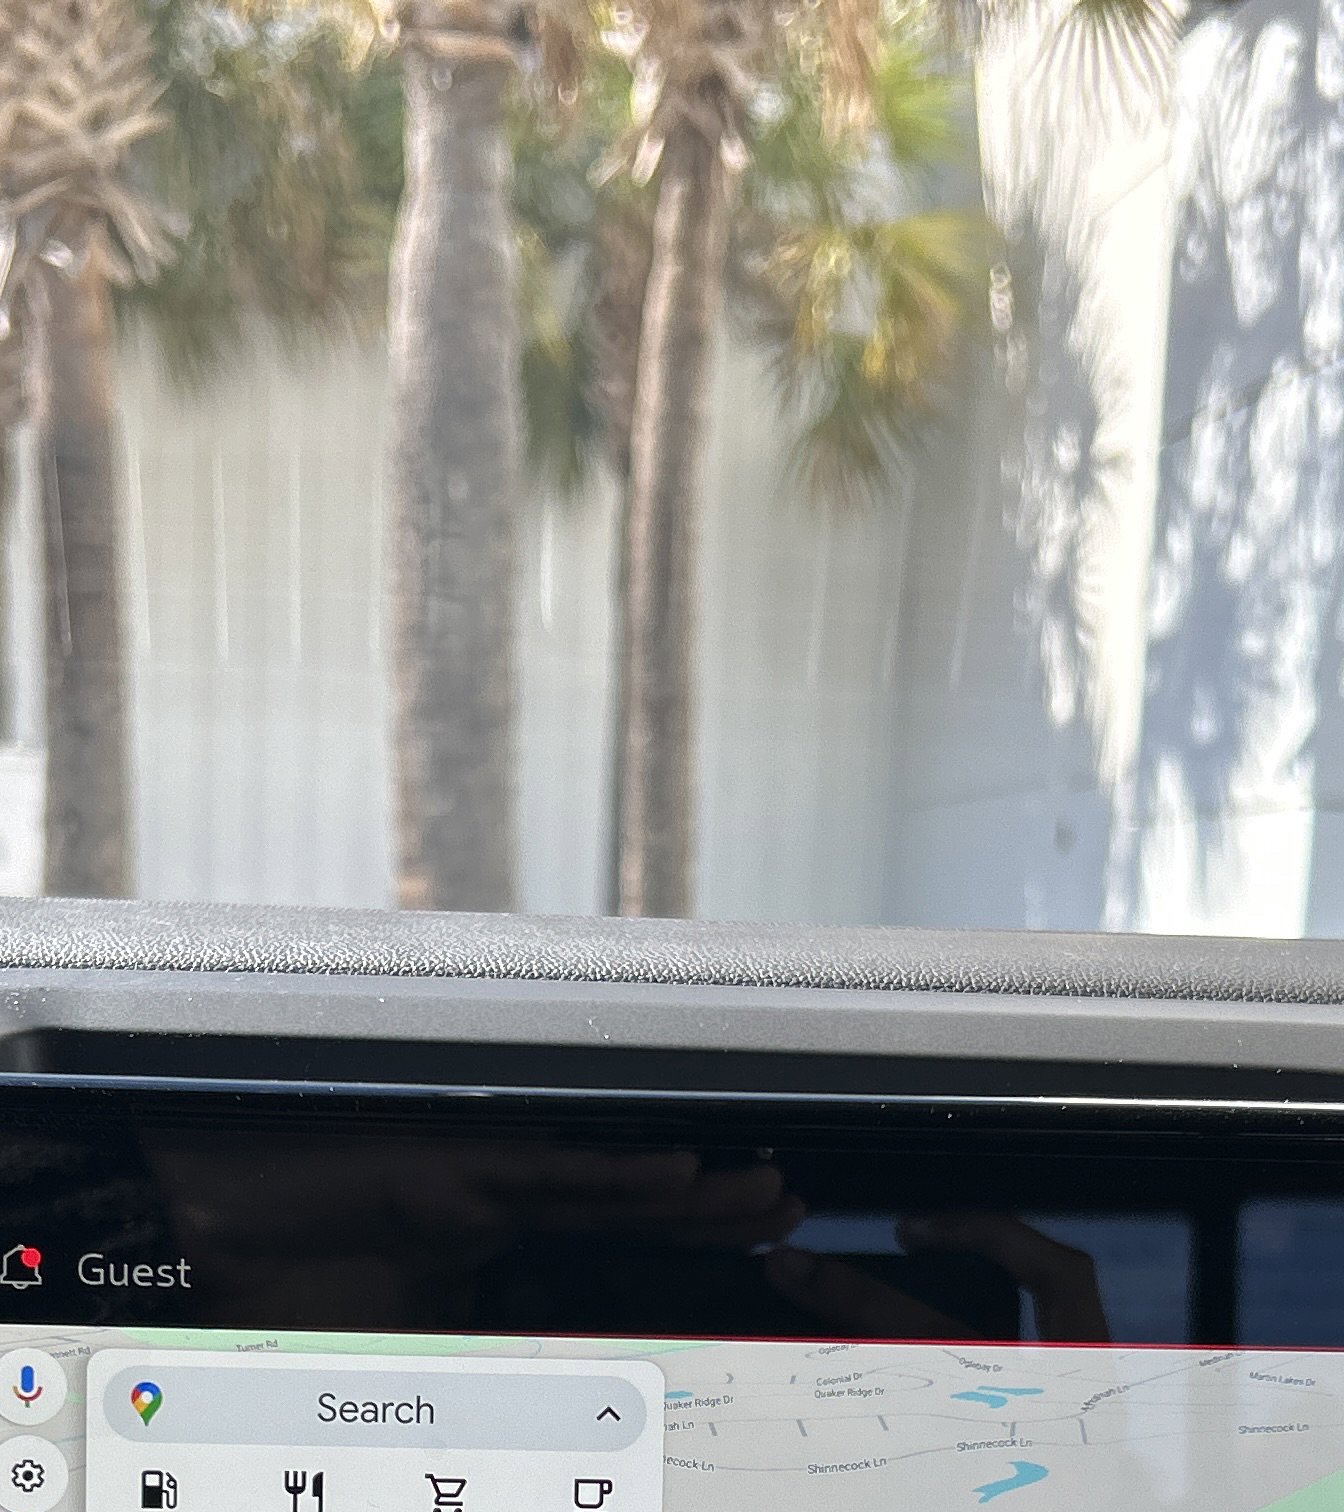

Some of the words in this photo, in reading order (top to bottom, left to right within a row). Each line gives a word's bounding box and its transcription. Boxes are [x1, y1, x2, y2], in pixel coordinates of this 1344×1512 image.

[77, 1252, 193, 1289] Guest
[853, 1372, 863, 1381] Dr
[814, 1389, 845, 1400] Quaker
[847, 1388, 873, 1399] Ridge
[874, 1387, 884, 1396] Dr
[317, 1392, 435, 1425] Search
[695, 1397, 722, 1409] Ridge
[723, 1394, 734, 1404] Dr
[682, 1420, 695, 1430] Ln
[1297, 1423, 1309, 1432] Ln
[956, 1438, 1017, 1453] Shinnecock
[1019, 1438, 1033, 1448] Ln
[701, 1461, 715, 1472] Ln
[807, 1459, 871, 1475] Shinnecock
[873, 1457, 887, 1467] Ln
